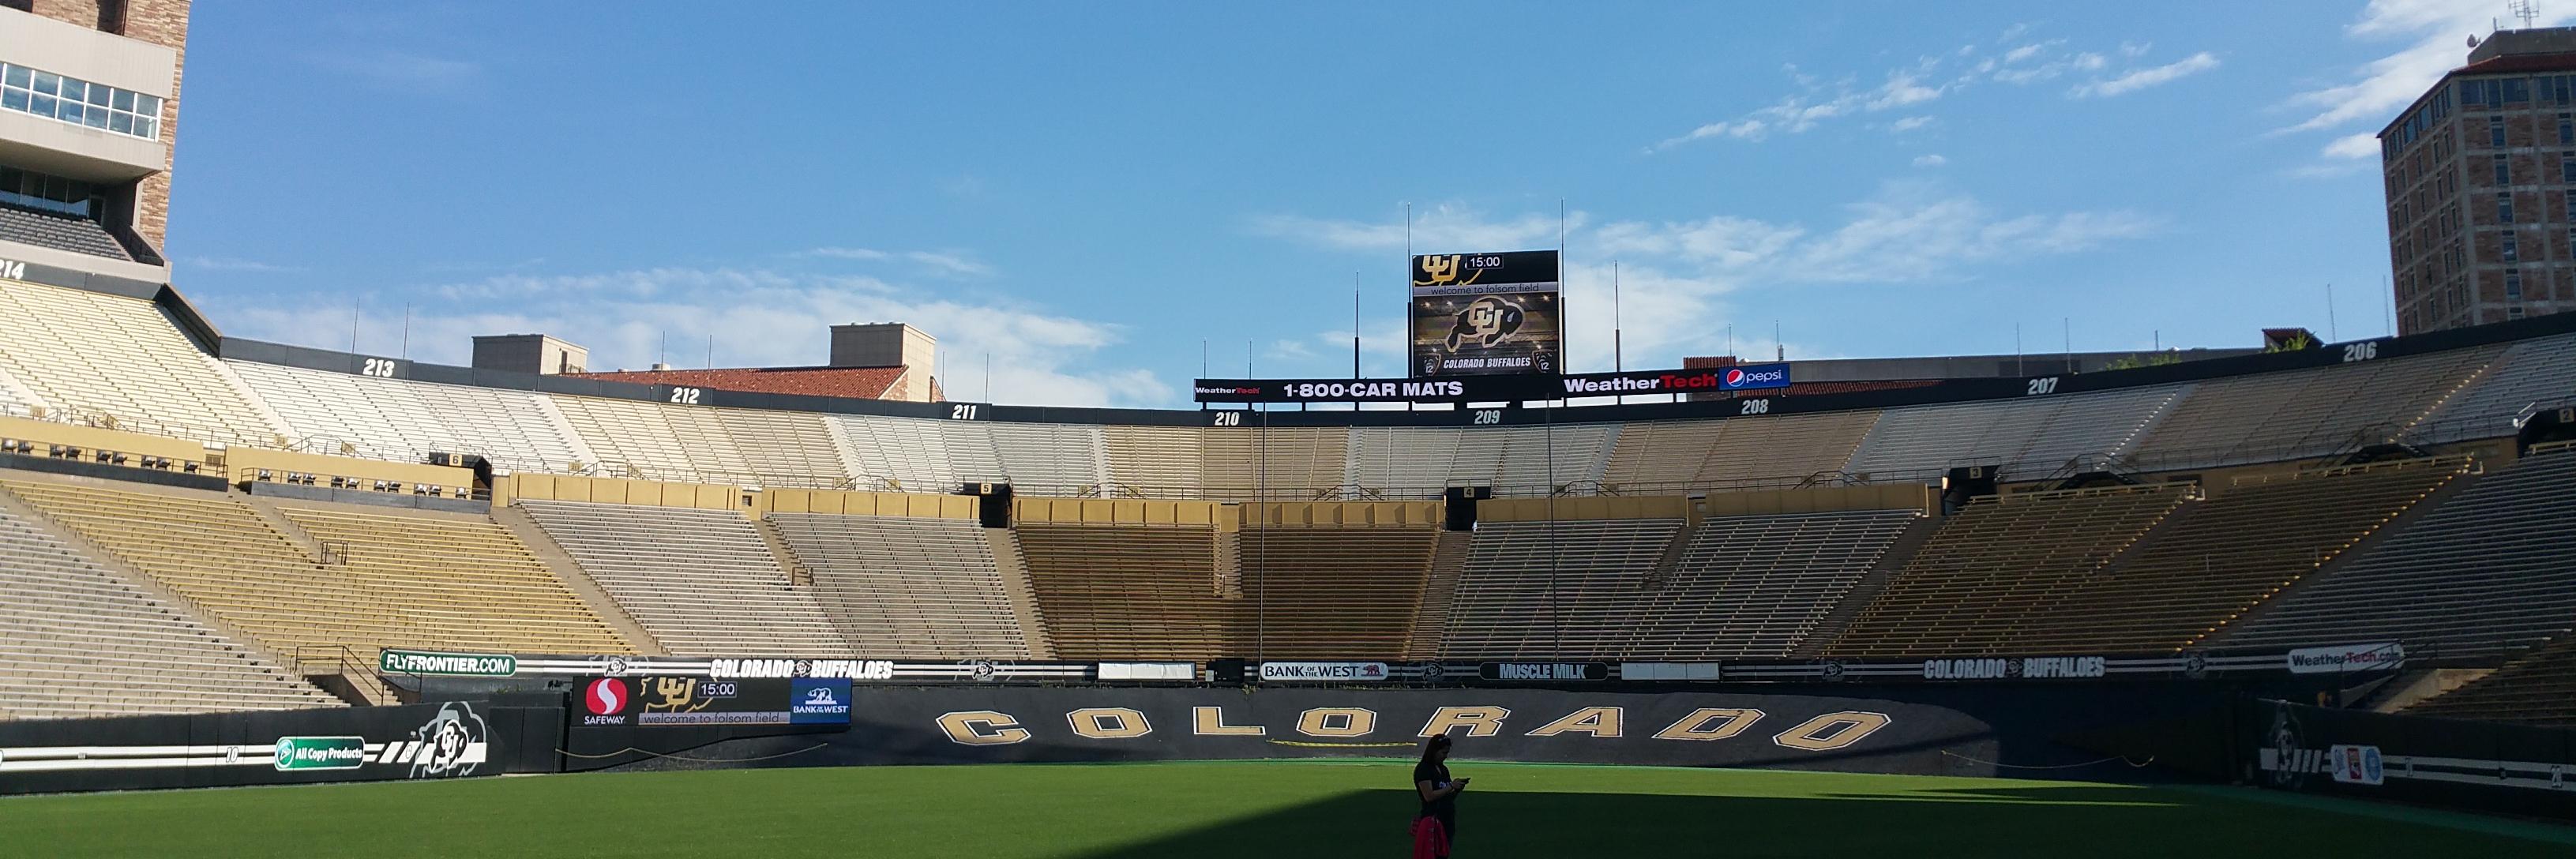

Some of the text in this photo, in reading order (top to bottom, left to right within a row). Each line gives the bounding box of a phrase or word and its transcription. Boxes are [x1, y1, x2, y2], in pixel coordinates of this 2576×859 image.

[1470, 256, 1500, 268] 15:00
[1430, 286, 1471, 295] welcome
[1486, 284, 1517, 293] folsom
[1519, 283, 1539, 292] field
[1468, 301, 1504, 334] CU
[2343, 341, 2377, 362] 206
[362, 358, 395, 377] 213
[1443, 357, 1531, 369] COLORADO BUFFALOES
[1564, 369, 1782, 392] WeatherTech pepsi
[2027, 377, 2059, 395] 207
[670, 387, 700, 404] 212
[1283, 381, 1463, 397] 1-800-CAR MATS
[952, 404, 977, 420] 211
[1740, 399, 1769, 414] 208
[1215, 411, 1240, 426] 210
[1474, 410, 1500, 425] 209
[452, 456, 459, 464] 6
[386, 654, 510, 673] FLYFRONTIER.COM
[709, 658, 795, 677] COLORADO
[809, 659, 894, 679] BUFFALOES
[1264, 666, 1304, 677] BANK
[1318, 666, 1358, 677] WEST
[1499, 663, 1587, 679] MUSCLE MILK
[1923, 658, 2007, 679] COLORADO
[2022, 656, 2106, 678] BUFFALOES
[700, 682, 735, 696] 15:00
[644, 711, 779, 724] welcome to folsom field
[793, 705, 817, 714] BANK
[824, 705, 849, 714] WEST
[584, 715, 625, 725] SAFEWAY
[935, 705, 1892, 751] COLORADO
[226, 747, 238, 763] 10
[295, 746, 362, 762] All Copy Products
